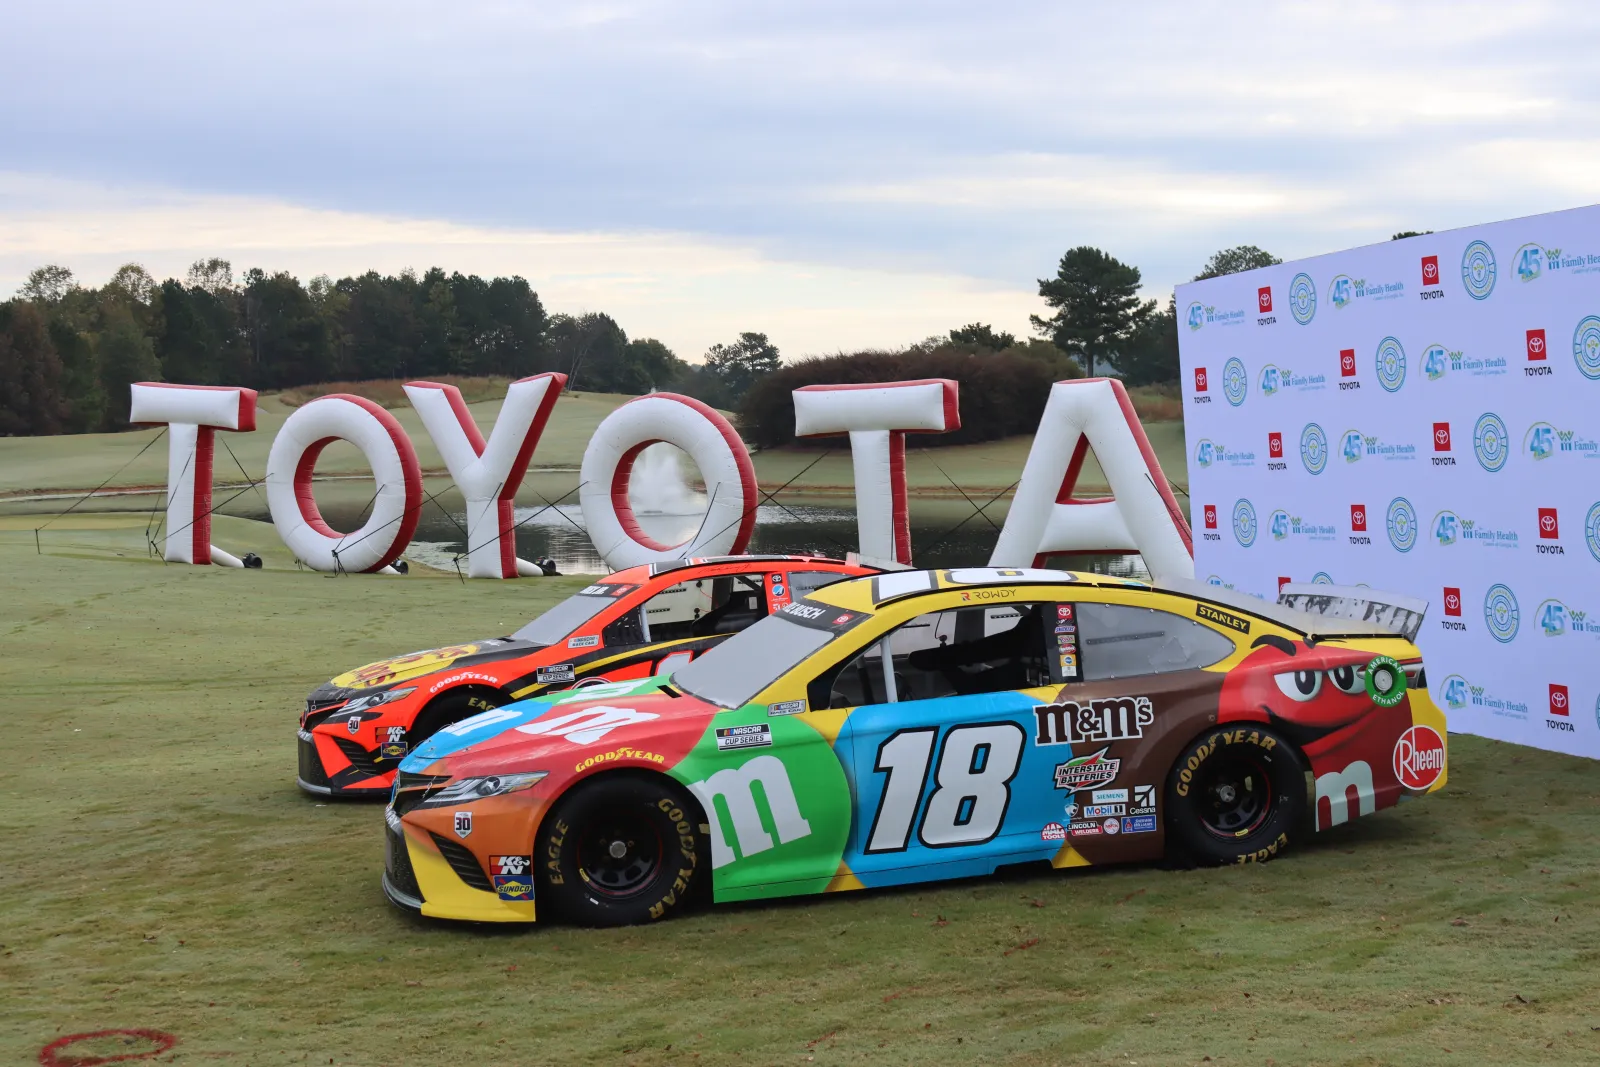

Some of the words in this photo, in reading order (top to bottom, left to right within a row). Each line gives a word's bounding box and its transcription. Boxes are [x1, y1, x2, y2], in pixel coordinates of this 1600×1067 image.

[1562, 256, 1585, 268] Family
[1365, 286, 1384, 297] Family
[1385, 281, 1404, 292] Health
[1420, 290, 1445, 301] TOYOTA
[1257, 317, 1276, 326] TOYOTA
[1463, 360, 1484, 370] Family
[1485, 358, 1507, 368] Health
[1524, 366, 1553, 377] TOYOTA
[1338, 382, 1361, 390] TOYOTA
[1194, 396, 1212, 404] TOYOTA
[1377, 446, 1396, 455] Family
[1396, 444, 1415, 453] Health
[1574, 440, 1599, 452] Family
[1267, 463, 1287, 471] TOYOTA
[1431, 457, 1456, 466] TOYOTA
[130, 372, 1193, 579] TOYOTA
[1349, 537, 1371, 545] TOYOTA
[1475, 530, 1495, 542] Family
[1496, 530, 1519, 541] Health
[1536, 545, 1565, 555] TOYOTA
[972, 589, 1016, 600] ROWDY
[1200, 606, 1246, 631] STANLEY
[1442, 621, 1467, 632] TOYOTA
[1367, 656, 1404, 677] AMERICAN
[429, 671, 498, 693] GOODYEAR
[1372, 689, 1405, 706] ETHANOL
[1484, 697, 1505, 711] Family
[1506, 700, 1528, 713] Health
[349, 720, 359, 730] 30
[733, 725, 762, 735] NASCAR
[1545, 720, 1575, 733] TOYOTA
[725, 736, 739, 745] CUP
[740, 734, 765, 744] SERIES
[575, 746, 665, 773] GOODYEAR
[1399, 727, 1444, 784] Rheem
[1058, 762, 1116, 775] INTERSTATE
[1176, 729, 1277, 797] GOODYEAR
[1060, 771, 1114, 784] BATTERIES
[867, 723, 1023, 854] 18
[1086, 805, 1112, 815] Mobil
[1114, 805, 1123, 813] 1
[1129, 807, 1156, 815] Cessna
[455, 817, 471, 831] 30
[1068, 822, 1096, 830] LINCOLN
[548, 819, 569, 885] EAGLE
[1237, 832, 1288, 864] EAGLE
[649, 798, 697, 919] GOODYEAR
[497, 885, 533, 894] SUNOCO
